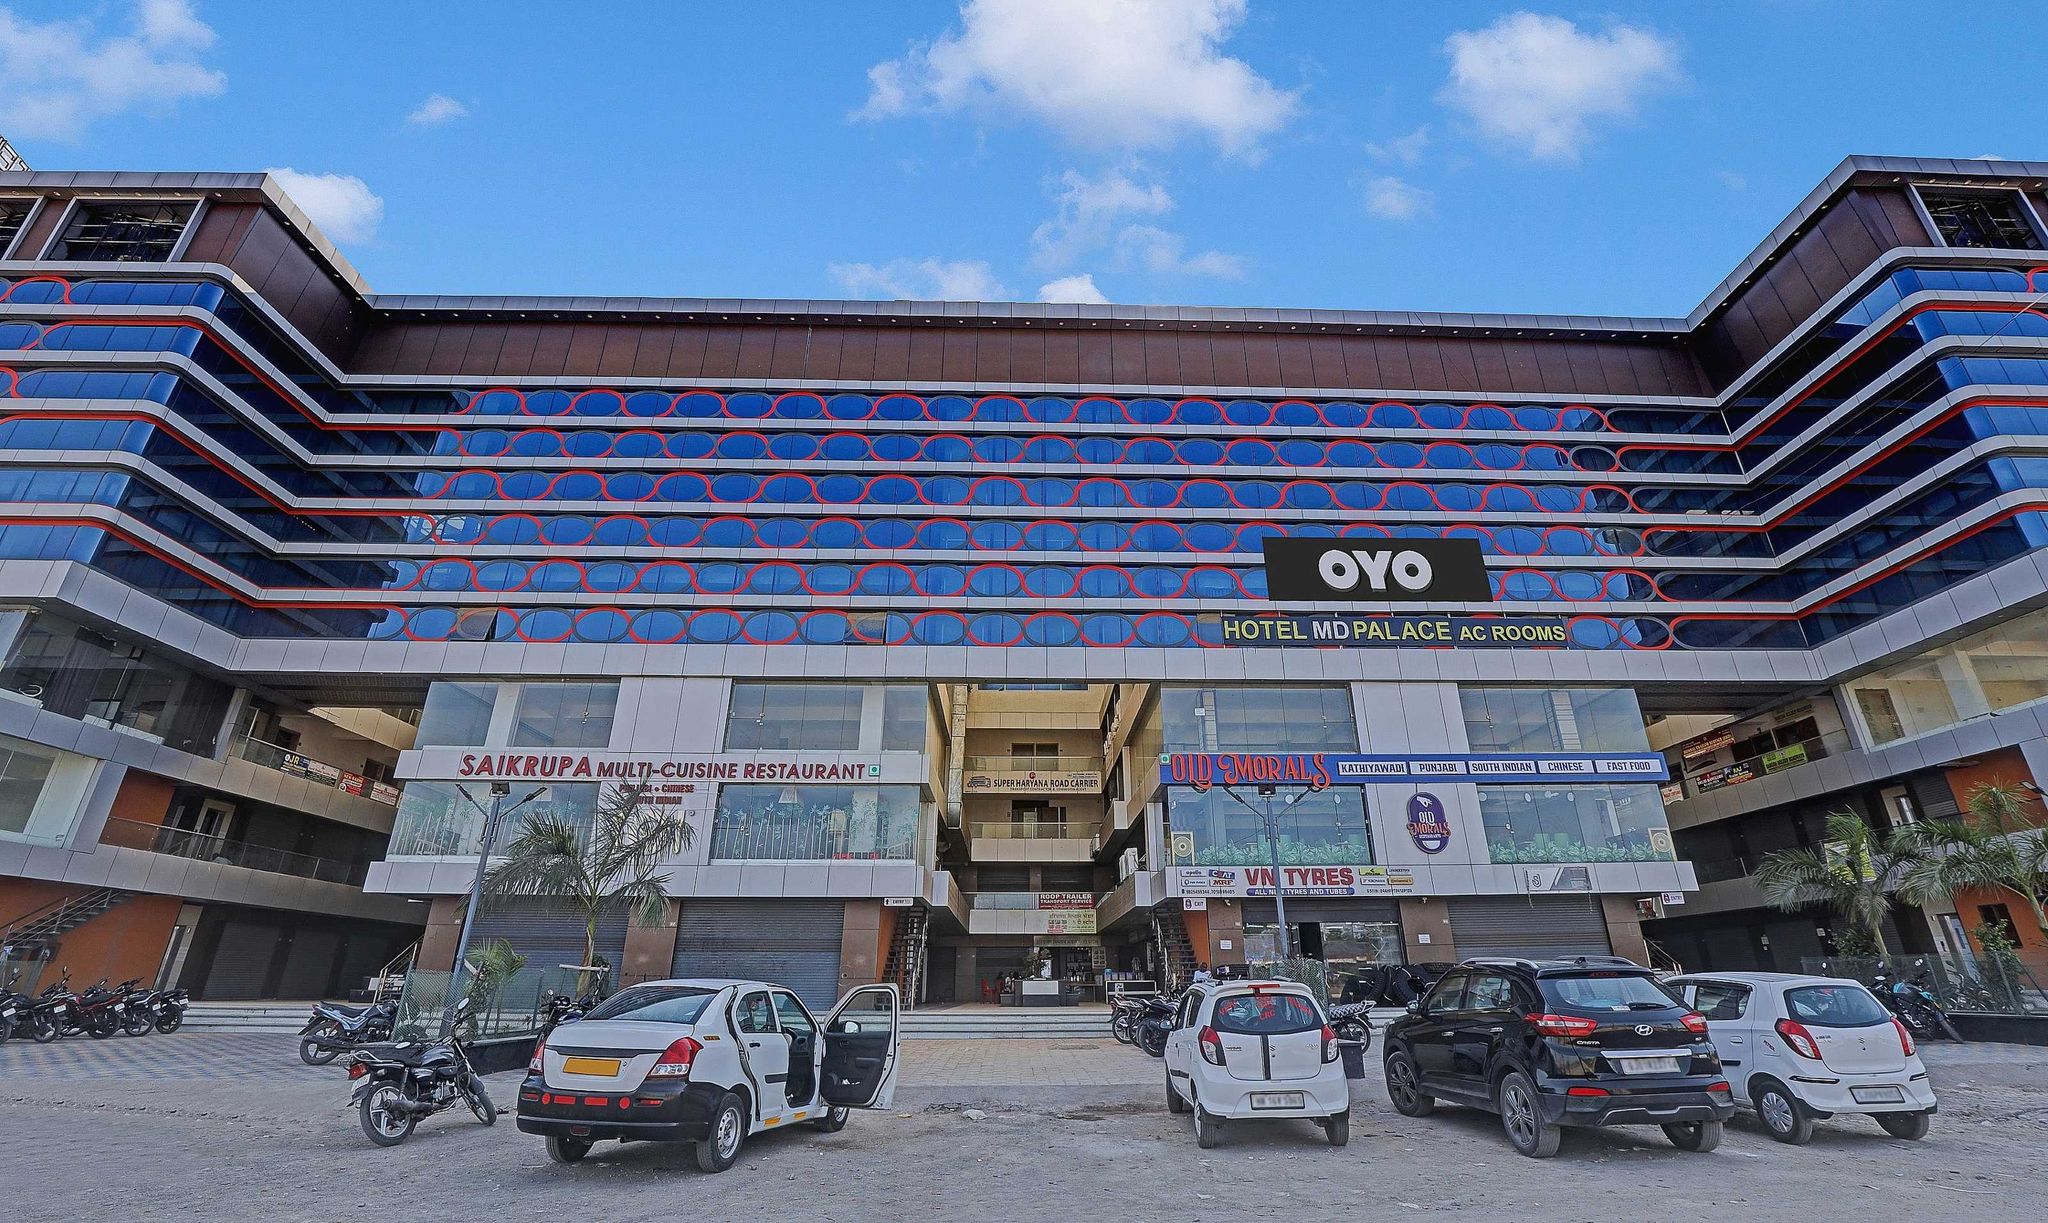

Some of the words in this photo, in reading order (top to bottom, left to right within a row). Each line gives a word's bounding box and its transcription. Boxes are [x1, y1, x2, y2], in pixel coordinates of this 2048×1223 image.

[1318, 549, 1433, 592] OYO
[1224, 619, 1307, 641] HOTEL
[1313, 620, 1350, 641] MD
[1353, 620, 1452, 642] PALACE
[1459, 625, 1487, 642] AC
[1491, 625, 1566, 642] ROOMS
[459, 754, 592, 777] SAIKRUPA
[596, 761, 738, 778] MULTI-CUISINE
[743, 763, 865, 779] RESTAURANT
[1171, 753, 1213, 790] OLD
[1217, 752, 1331, 789] MORALS
[1341, 763, 1405, 775] KATHIYAWADI
[1419, 762, 1457, 773] PUNJABI
[1472, 762, 1500, 772] SOUTH
[1502, 762, 1532, 772] INDIAN
[1548, 762, 1584, 772] CHINESE
[1607, 761, 1627, 771] FAST
[1630, 761, 1650, 771] FOOD
[993, 779, 1015, 787] SUPER
[1016, 779, 1048, 788] HARYANA
[1050, 779, 1069, 788] ROAD
[1070, 779, 1098, 788] CARRIER
[1418, 811, 1435, 826] OLD
[1245, 868, 1276, 886] VN
[1284, 868, 1354, 886] TYRES
